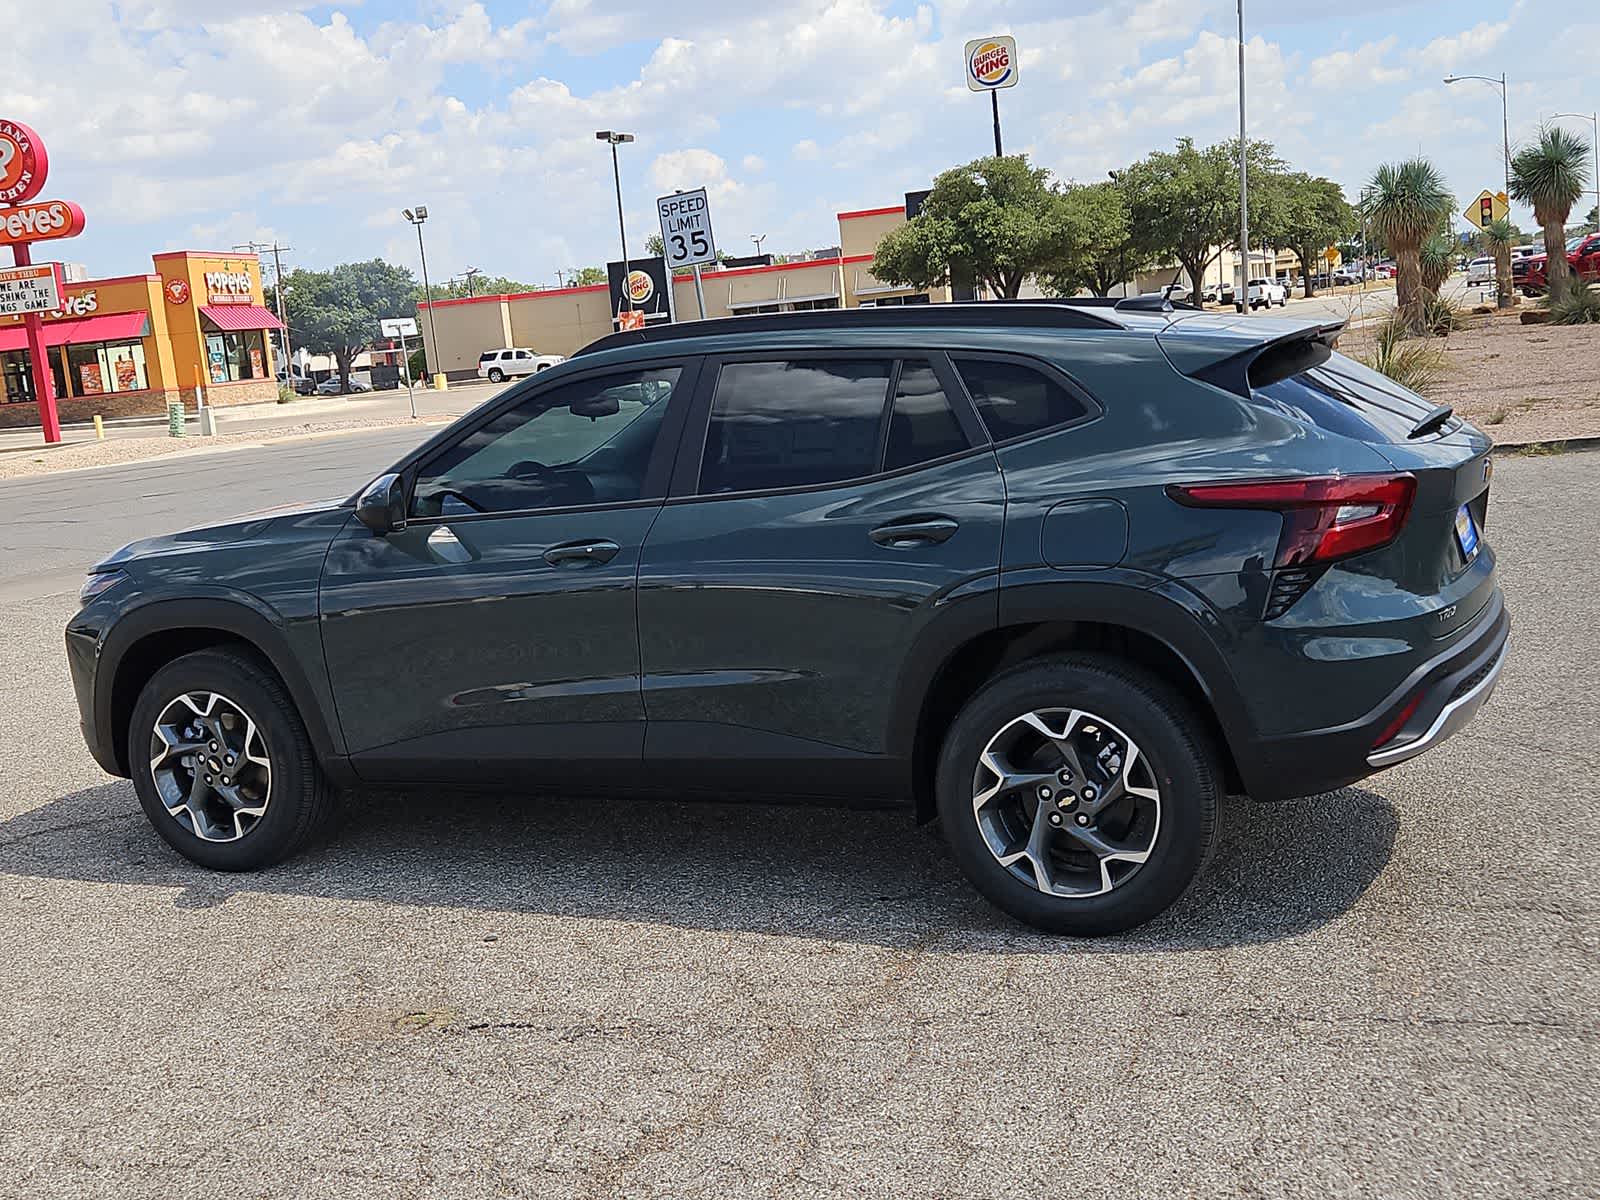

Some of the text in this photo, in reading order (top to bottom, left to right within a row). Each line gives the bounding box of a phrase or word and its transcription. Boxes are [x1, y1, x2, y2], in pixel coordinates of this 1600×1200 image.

[974, 47, 1007, 67] BURGER
[976, 54, 1009, 78] KING
[661, 197, 705, 217] SPEED
[668, 213, 701, 233] LIMIT
[671, 230, 709, 261] 35
[18, 269, 39, 279] THRU
[19, 279, 35, 289] ARE
[33, 288, 49, 299] THE
[25, 298, 49, 310] GAME
